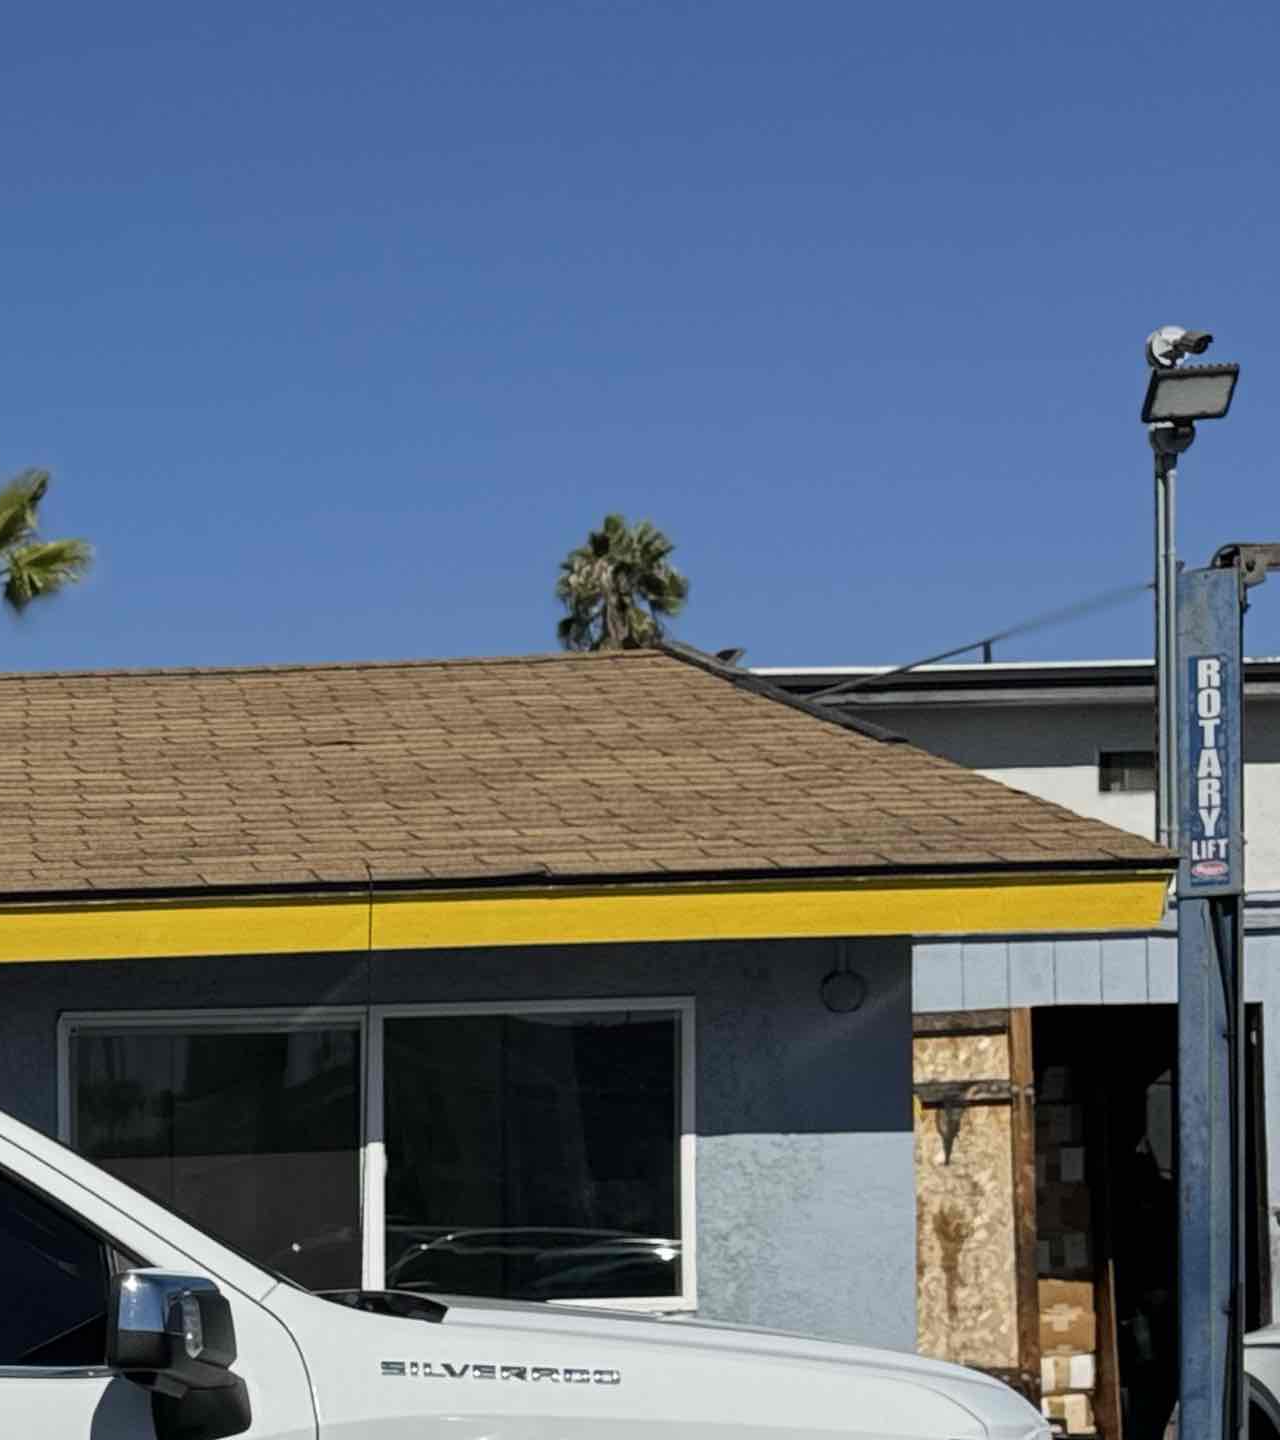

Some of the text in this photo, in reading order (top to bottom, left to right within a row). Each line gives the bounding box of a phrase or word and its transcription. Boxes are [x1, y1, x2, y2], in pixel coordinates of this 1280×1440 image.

[1197, 658, 1222, 837] ROTARY
[1191, 839, 1228, 861] LIFT
[380, 1360, 621, 1385] SILVERADO
